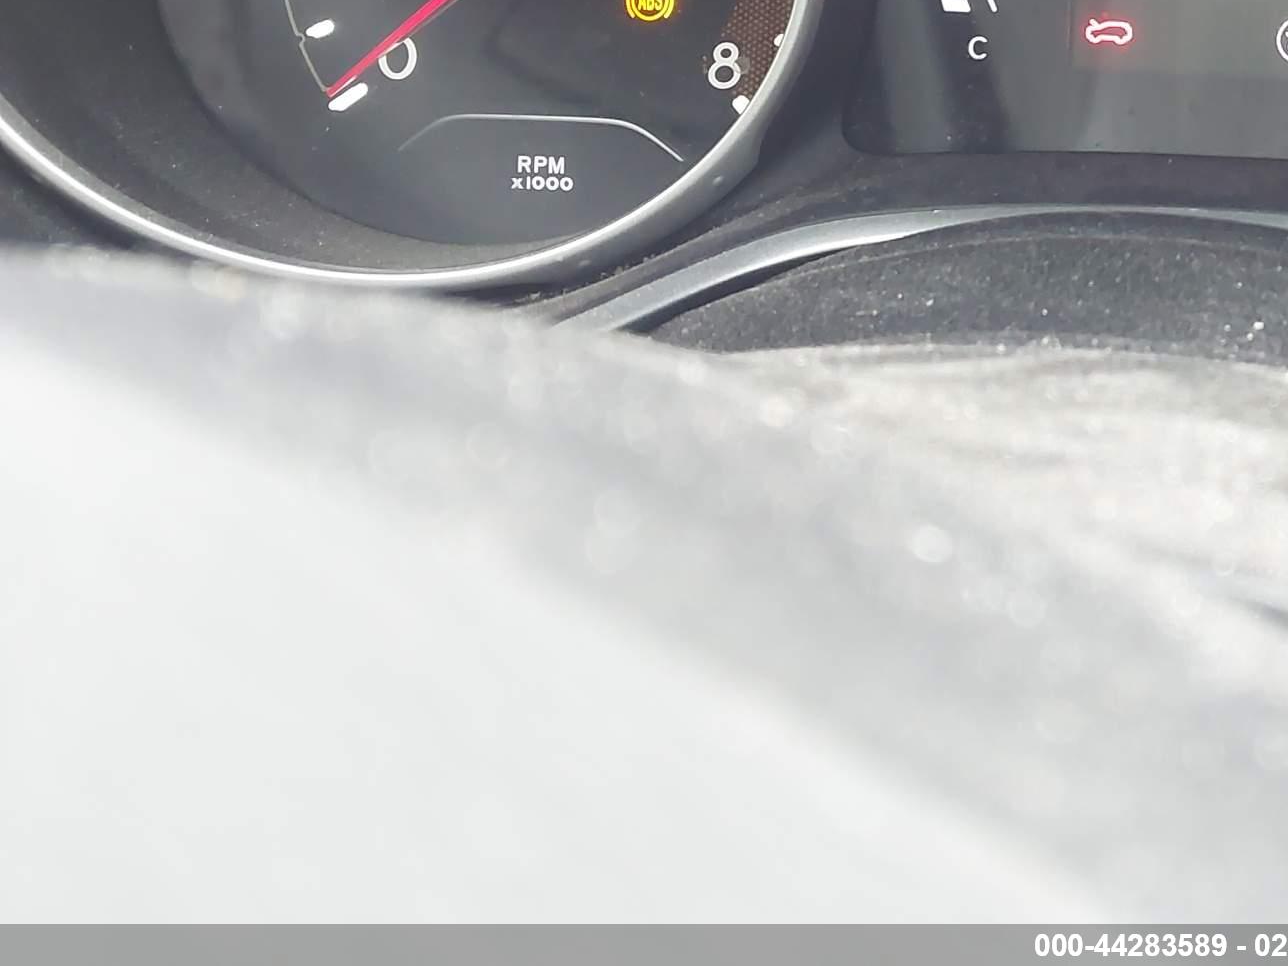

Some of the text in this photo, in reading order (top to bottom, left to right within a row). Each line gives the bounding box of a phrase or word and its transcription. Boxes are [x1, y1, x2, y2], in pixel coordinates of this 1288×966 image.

[377, 37, 418, 80] 0
[968, 36, 988, 60] C
[707, 41, 742, 90] 8
[517, 155, 565, 175] RPM
[511, 175, 574, 192] x1000
